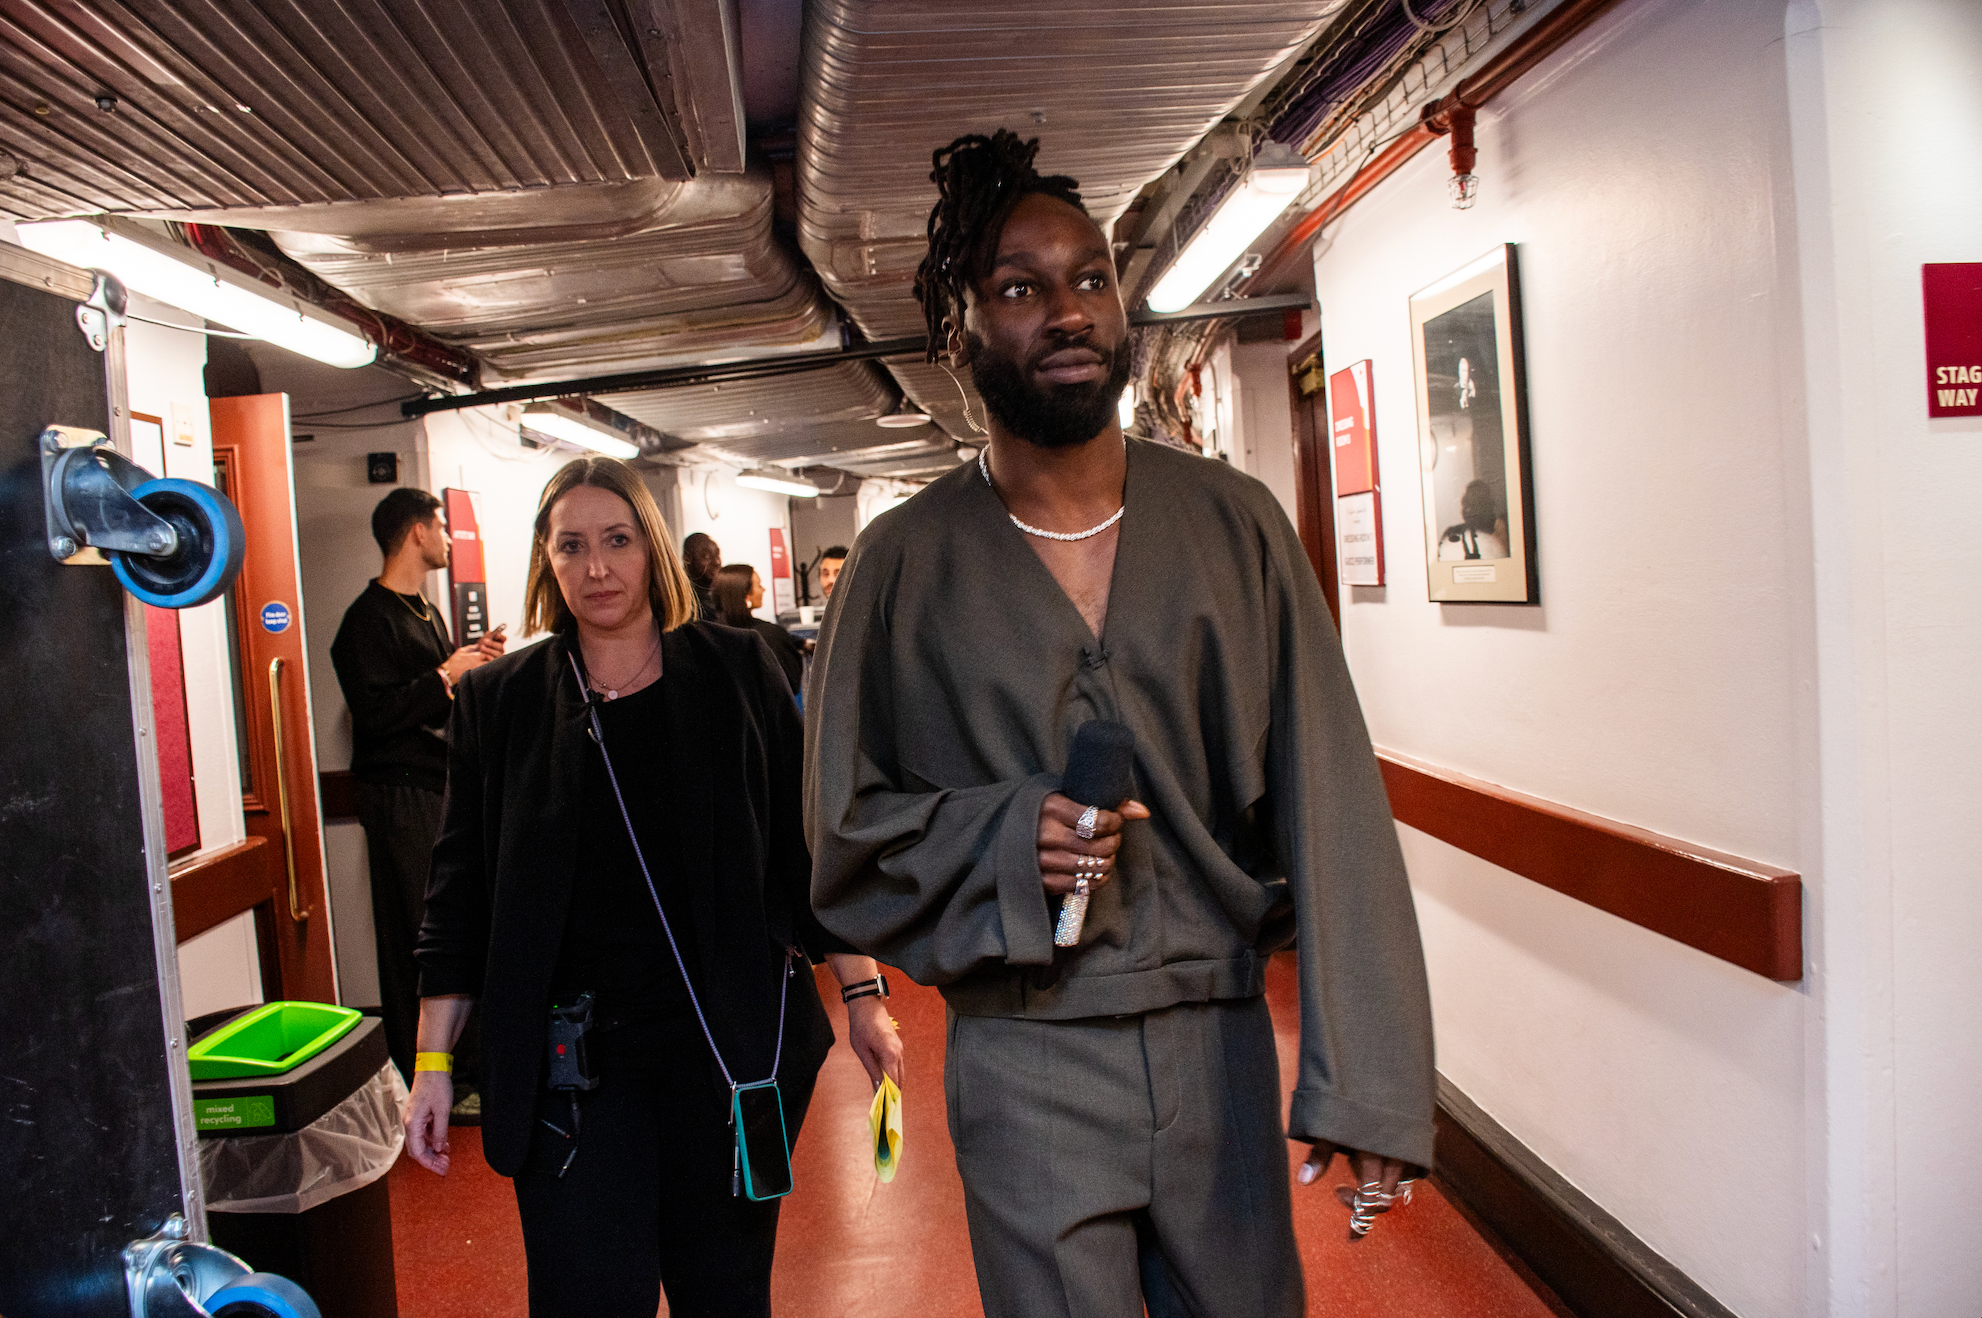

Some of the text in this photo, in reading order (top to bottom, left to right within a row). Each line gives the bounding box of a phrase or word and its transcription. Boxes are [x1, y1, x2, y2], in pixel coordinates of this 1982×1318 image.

[1937, 388, 1978, 407] WAY
[206, 1104, 234, 1114] mixed
[200, 1114, 241, 1125] recycling
